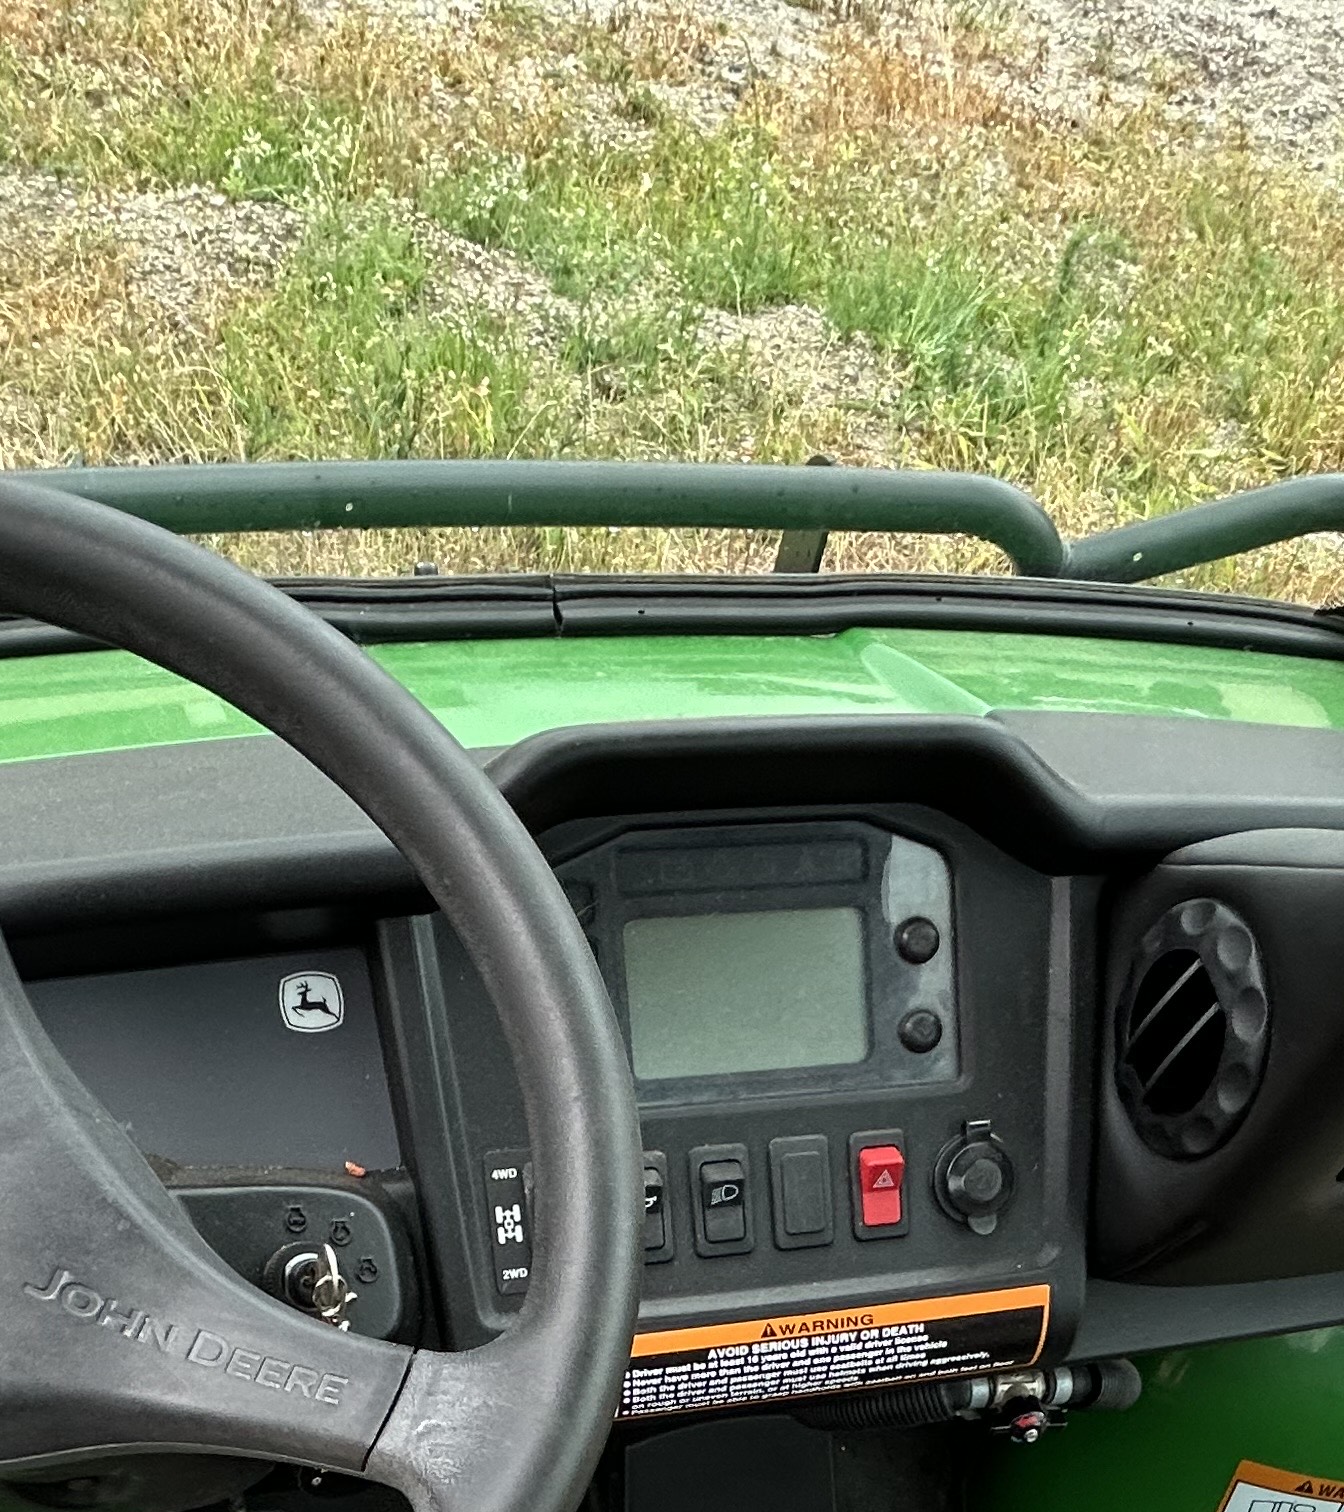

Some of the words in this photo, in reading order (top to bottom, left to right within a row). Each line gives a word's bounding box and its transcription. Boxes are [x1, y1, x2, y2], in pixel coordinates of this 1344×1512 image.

[491, 1167, 518, 1180] 4WD
[502, 1267, 528, 1280] 2WD
[24, 1267, 179, 1352] JOHN
[186, 1328, 349, 1405] DEERE
[708, 1344, 748, 1359] AVOID
[751, 1336, 809, 1354] SERIOUS
[810, 1331, 856, 1346] INJURY
[860, 1328, 879, 1340] OR
[881, 1322, 924, 1338] DEATH
[779, 1315, 873, 1335] WARNING
[632, 1366, 663, 1378] Driver
[665, 1363, 690, 1374] must
[693, 1361, 705, 1370] be
[708, 1360, 717, 1368] at
[719, 1356, 744, 1367] least
[747, 1355, 758, 1364] 16
[760, 1351, 788, 1363] years
[790, 1348, 805, 1358] old
[808, 1345, 828, 1355] with
[839, 1341, 862, 1352] valid
[865, 1338, 892, 1348] driver
[895, 1333, 928, 1345] license
[632, 1376, 661, 1387] Never
[664, 1372, 688, 1383] have
[691, 1370, 715, 1380] more
[718, 1366, 740, 1376] than
[743, 1364, 758, 1373] the
[761, 1360, 789, 1370] driver
[792, 1357, 810, 1366] and
[813, 1356, 830, 1364] one
[833, 1349, 882, 1362] passenger
[896, 1344, 911, 1353] the
[914, 1339, 947, 1351] vehicle
[633, 1385, 656, 1395] Both
[659, 1384, 674, 1392] the
[677, 1380, 706, 1389] driver
[709, 1377, 726, 1385] and
[730, 1371, 780, 1384] passenger
[784, 1367, 807, 1376] must
[830, 1358, 872, 1370] seatbelts
[900, 1351, 925, 1361] times
[633, 1393, 655, 1403] Both
[659, 1391, 674, 1399] the
[677, 1387, 705, 1397] driver
[708, 1385, 726, 1393] and
[729, 1378, 778, 1392] passenger
[783, 1374, 806, 1383] must
[809, 1372, 825, 1380] use
[828, 1367, 865, 1378] helmets
[869, 1363, 892, 1372] when
[895, 1359, 927, 1370] driving
[930, 1350, 989, 1365] aggressively,
